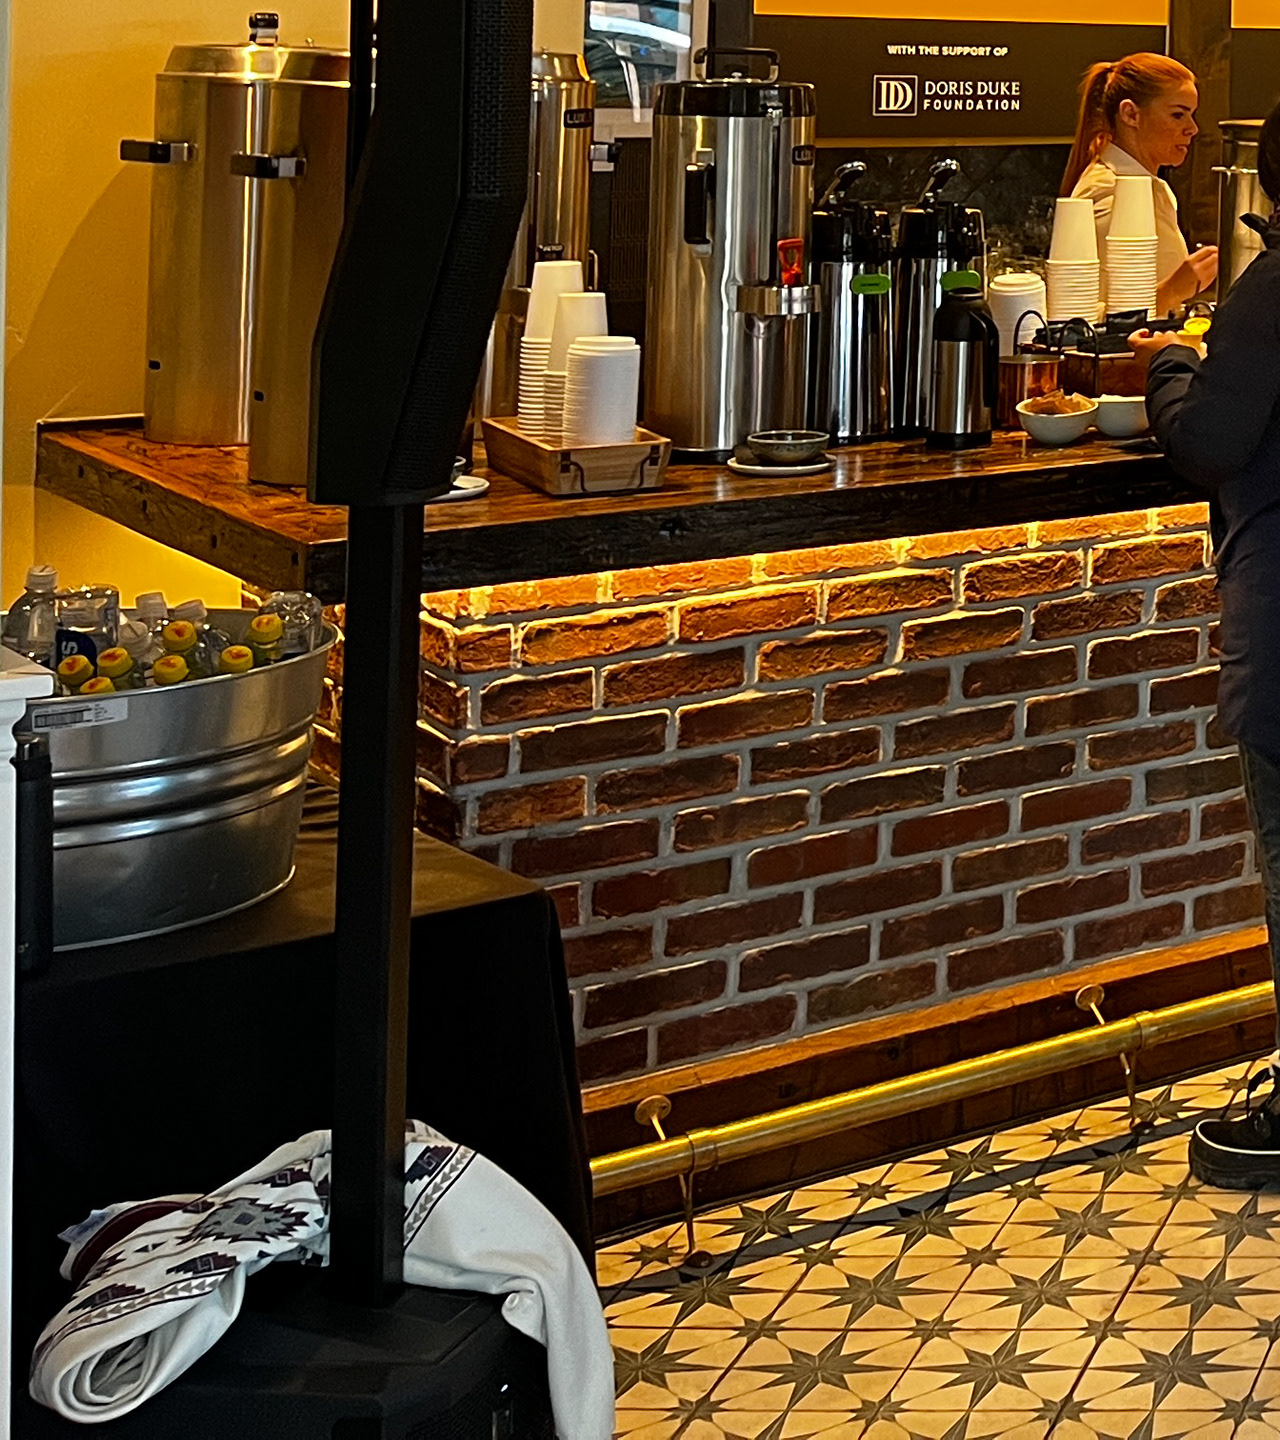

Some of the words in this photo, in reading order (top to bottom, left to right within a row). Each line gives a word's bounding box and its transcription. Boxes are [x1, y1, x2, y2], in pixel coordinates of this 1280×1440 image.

[887, 45, 916, 55] WITH
[918, 45, 940, 55] THE
[941, 46, 992, 56] SUPPORT
[993, 47, 1009, 57] OF
[925, 81, 974, 96] DORIS
[976, 81, 1021, 96] DUKE
[923, 99, 1020, 111] FOUNDATION
